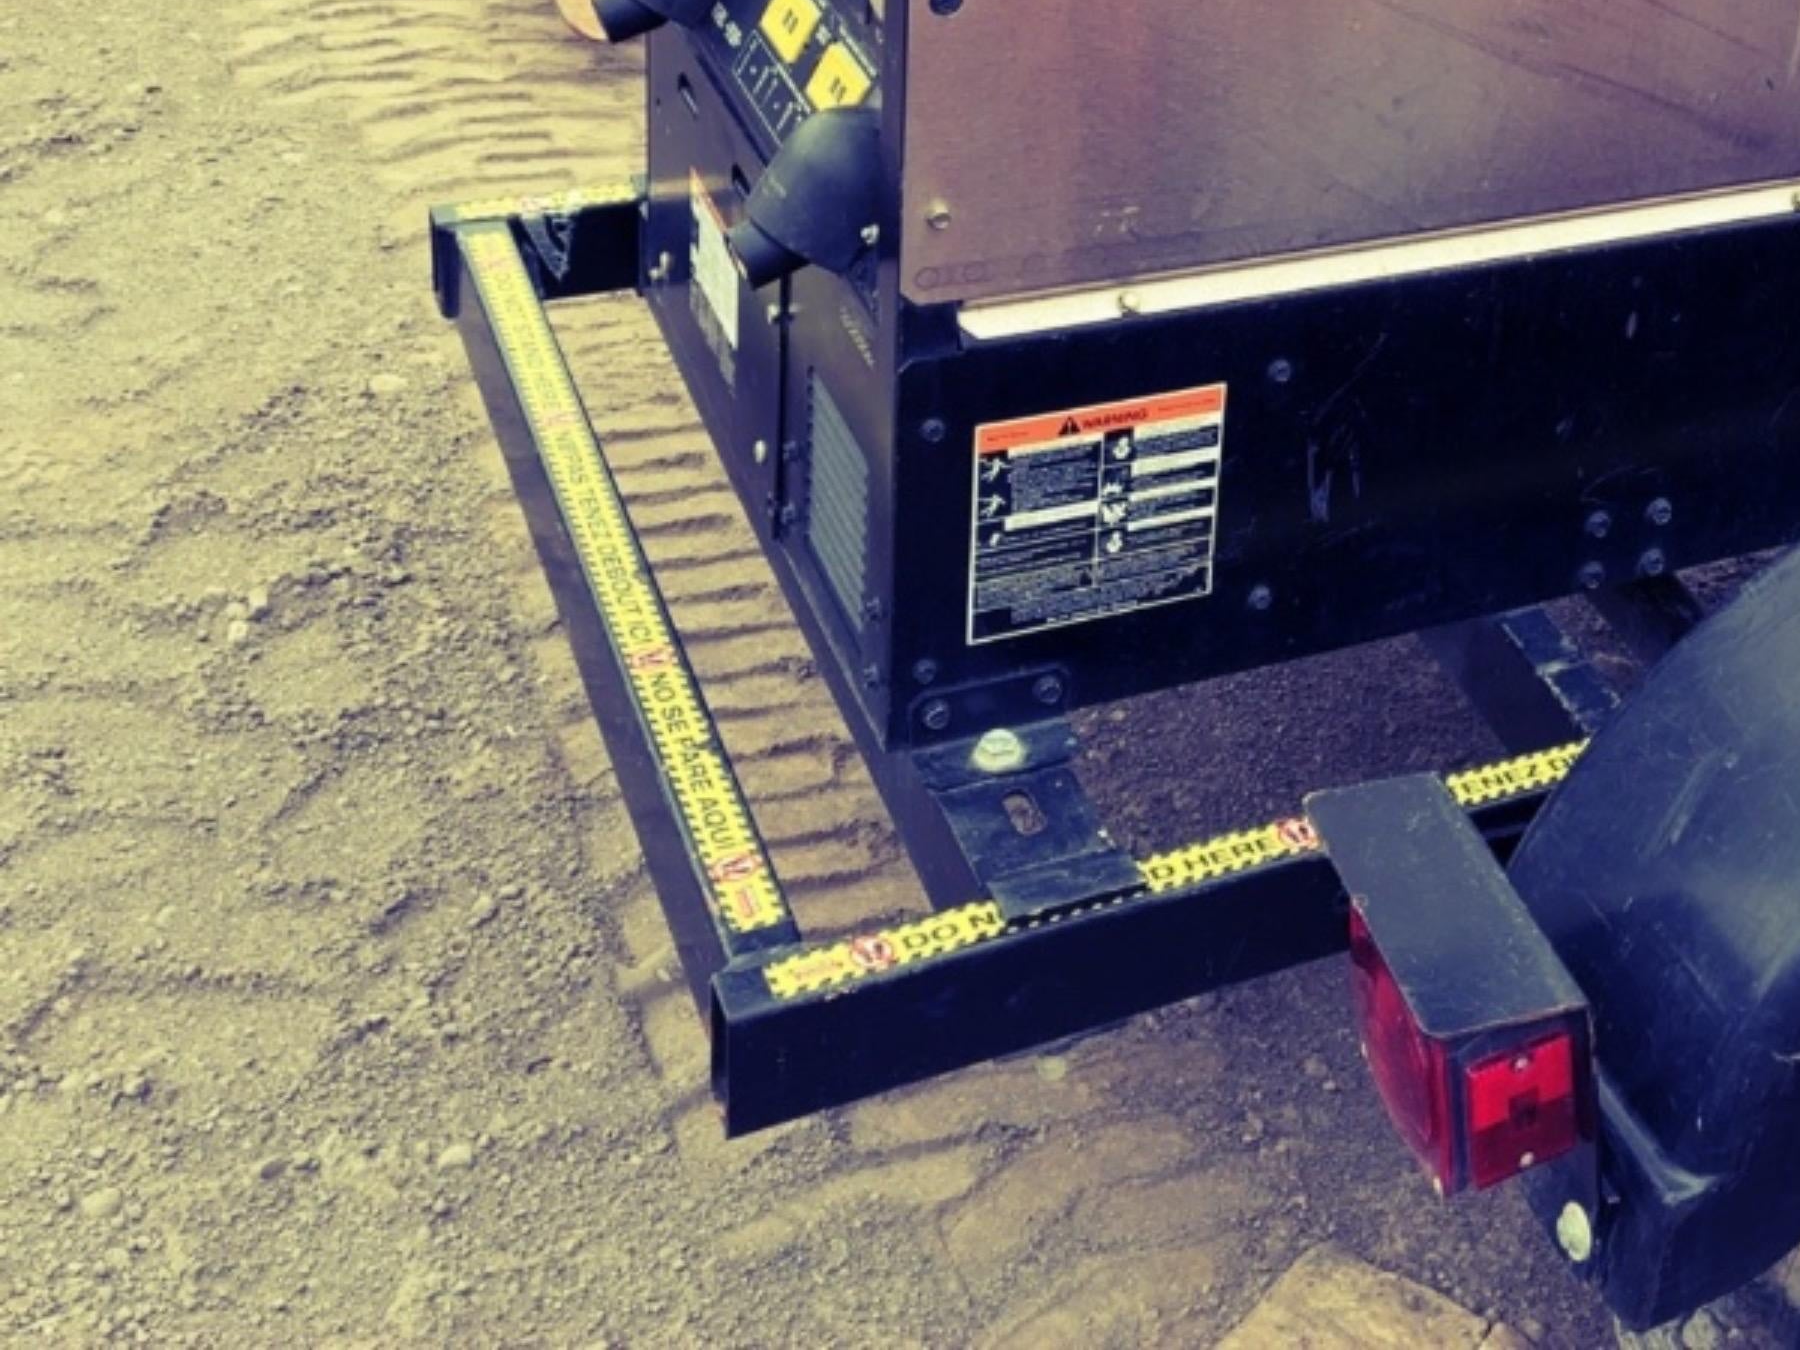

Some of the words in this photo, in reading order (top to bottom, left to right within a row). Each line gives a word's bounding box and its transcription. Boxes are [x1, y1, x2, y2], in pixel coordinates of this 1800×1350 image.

[1082, 407, 1148, 430] WARNING
[649, 670, 678, 703] NO
[660, 704, 690, 734] SE
[676, 735, 716, 793] PARE
[1460, 763, 1538, 794] ENEZ
[698, 795, 737, 852] AQUI
[901, 922, 959, 950] DO
